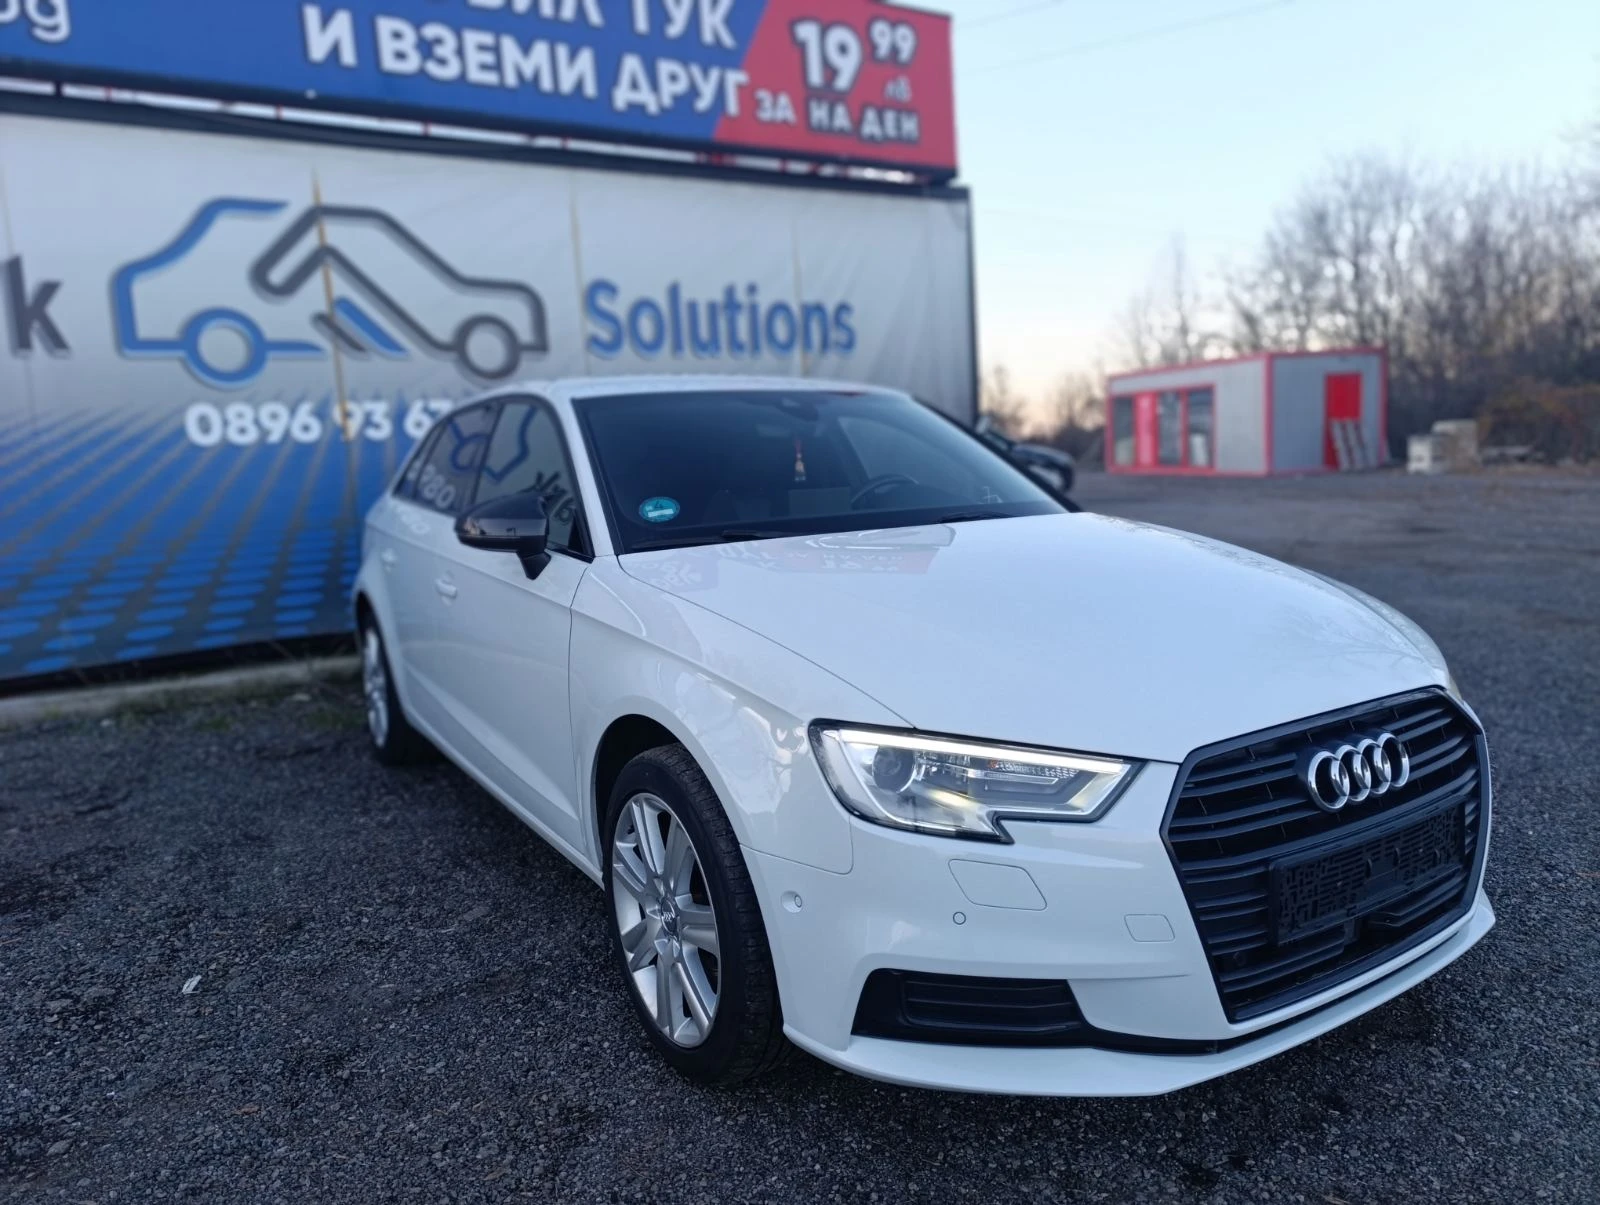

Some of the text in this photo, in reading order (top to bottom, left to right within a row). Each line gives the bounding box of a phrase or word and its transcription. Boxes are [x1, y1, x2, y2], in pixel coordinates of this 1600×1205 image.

[303, 4, 750, 117] И ВЗЕМИ ДРУГ
[793, 19, 916, 91] 19 99
[755, 90, 919, 140] ЗА НА ДЕН
[585, 278, 856, 355] Solutions
[184, 402, 323, 446] 0896
[333, 400, 392, 441] 93
